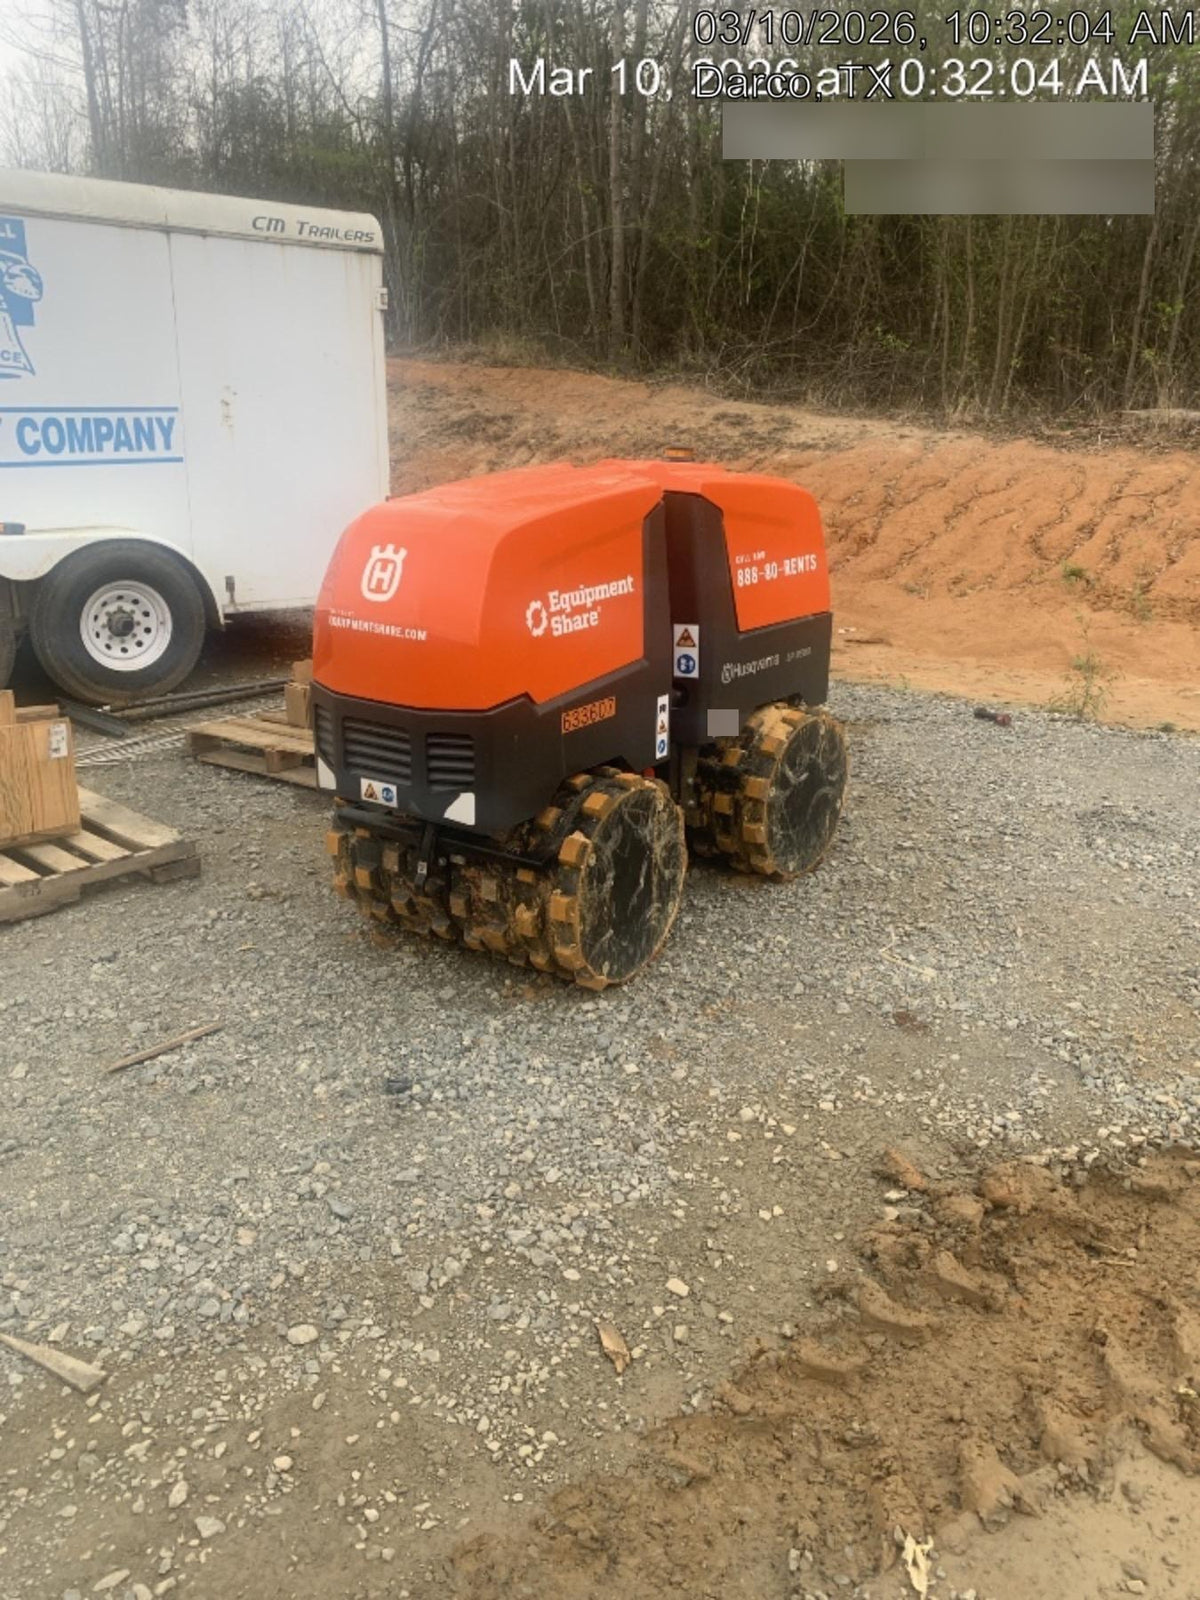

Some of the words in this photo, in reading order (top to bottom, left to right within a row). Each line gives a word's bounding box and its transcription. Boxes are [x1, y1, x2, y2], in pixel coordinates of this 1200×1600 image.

[252, 216, 286, 233] CM
[16, 416, 176, 456] COMPANY
[548, 574, 634, 613] Equipment
[551, 610, 599, 637] Share
